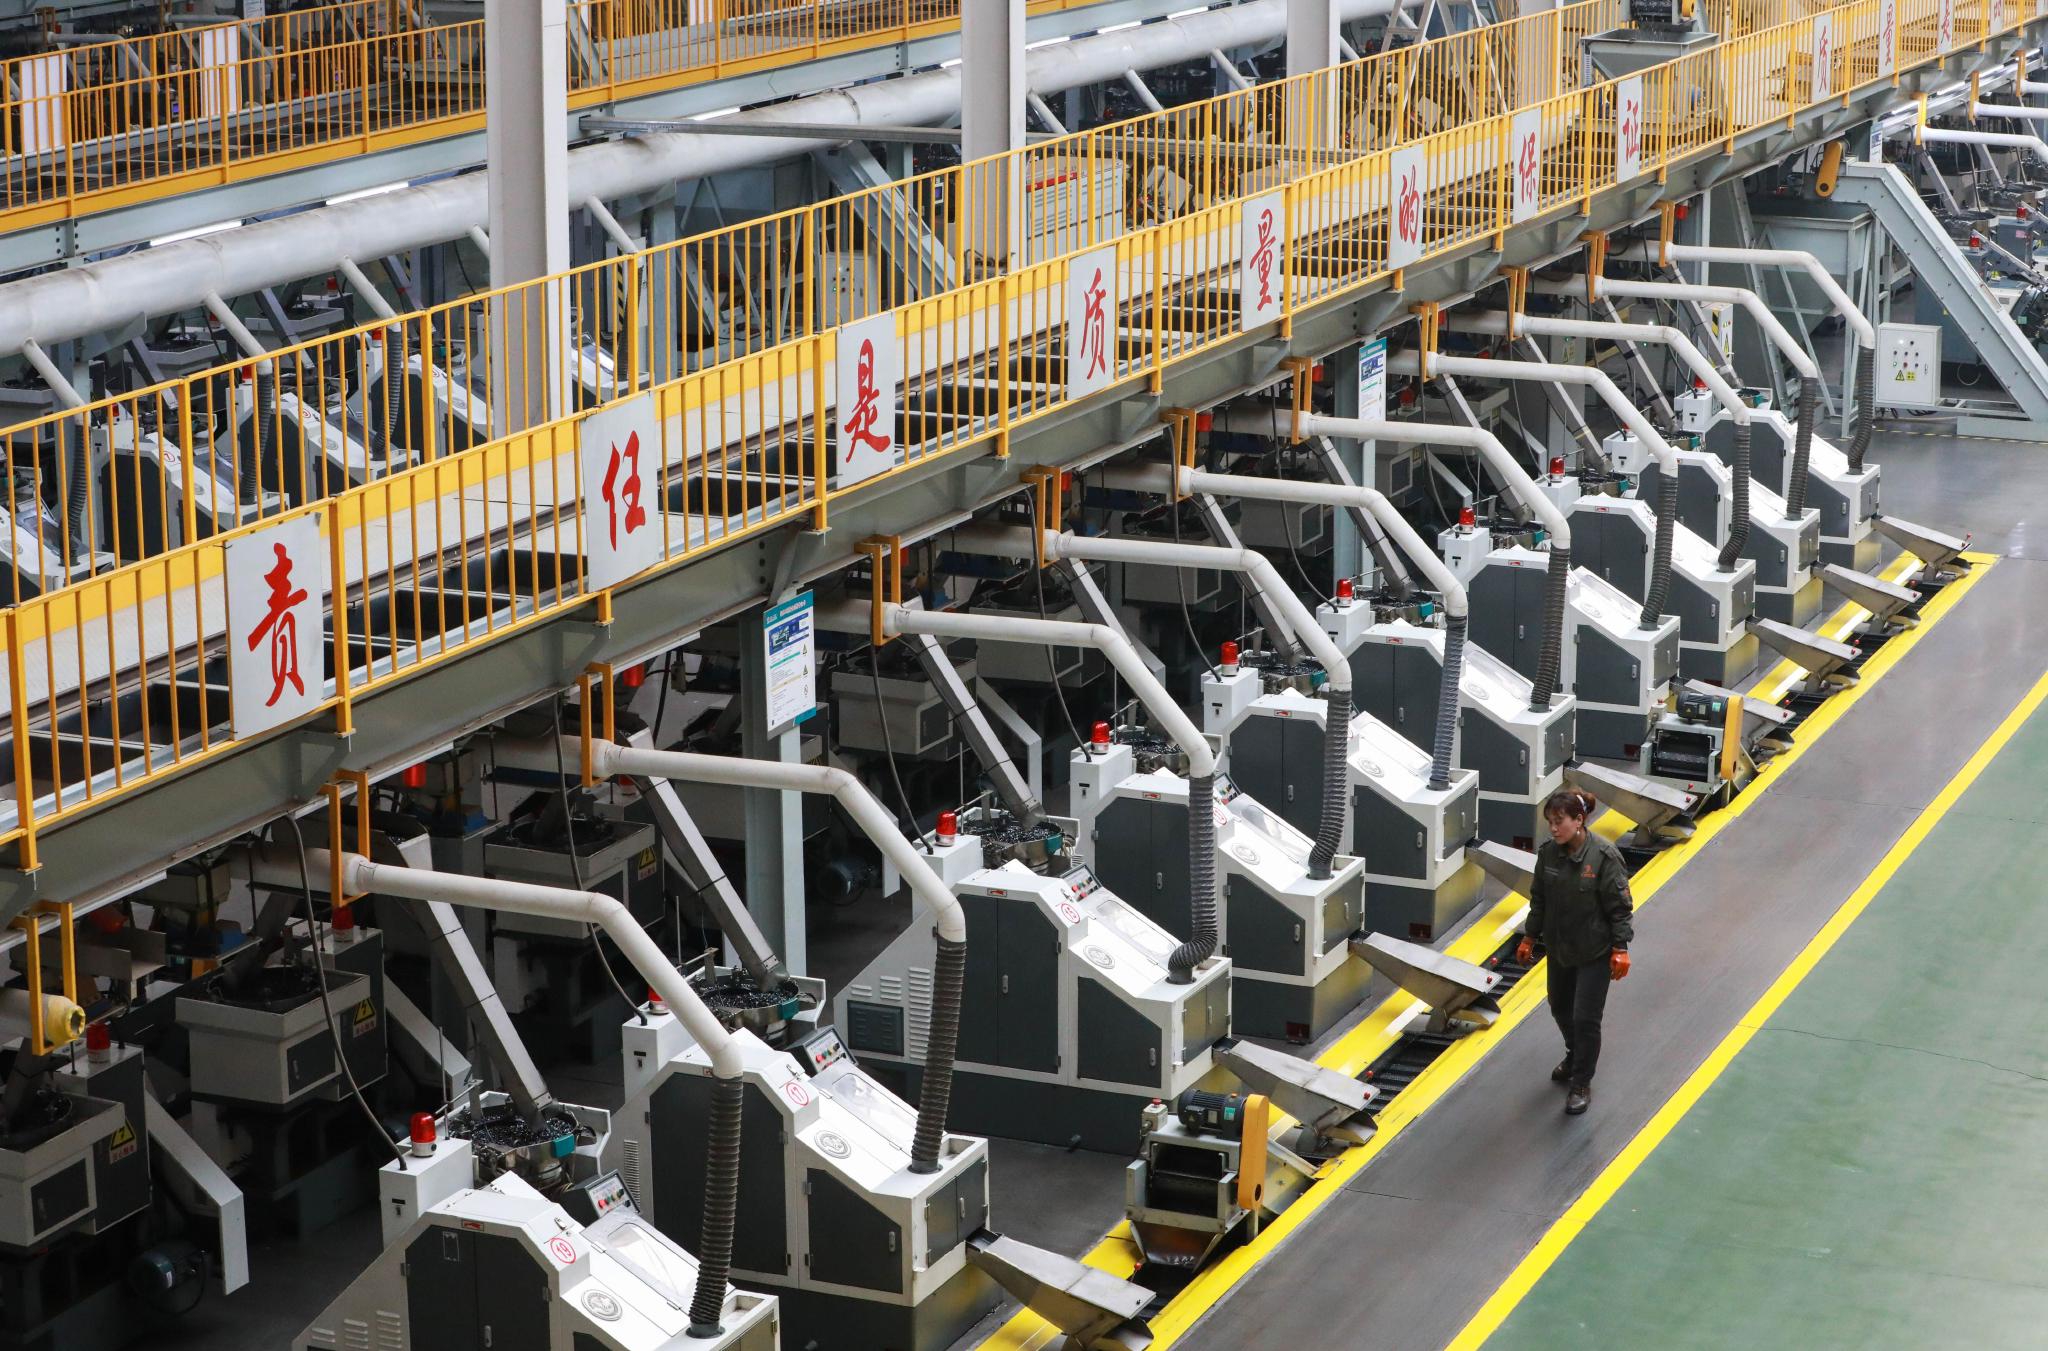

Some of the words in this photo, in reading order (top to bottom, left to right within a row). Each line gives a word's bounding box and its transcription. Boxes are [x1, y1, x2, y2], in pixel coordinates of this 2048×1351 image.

[1883, 3, 1894, 66] 量
[247, 542, 309, 708] 责
[601, 430, 646, 552] 任
[843, 338, 892, 464] 是
[1080, 267, 1107, 380] 质
[1250, 208, 1277, 311] 量
[1399, 164, 1420, 246] 的
[1519, 131, 1537, 204] 保
[1622, 99, 1640, 164] 证
